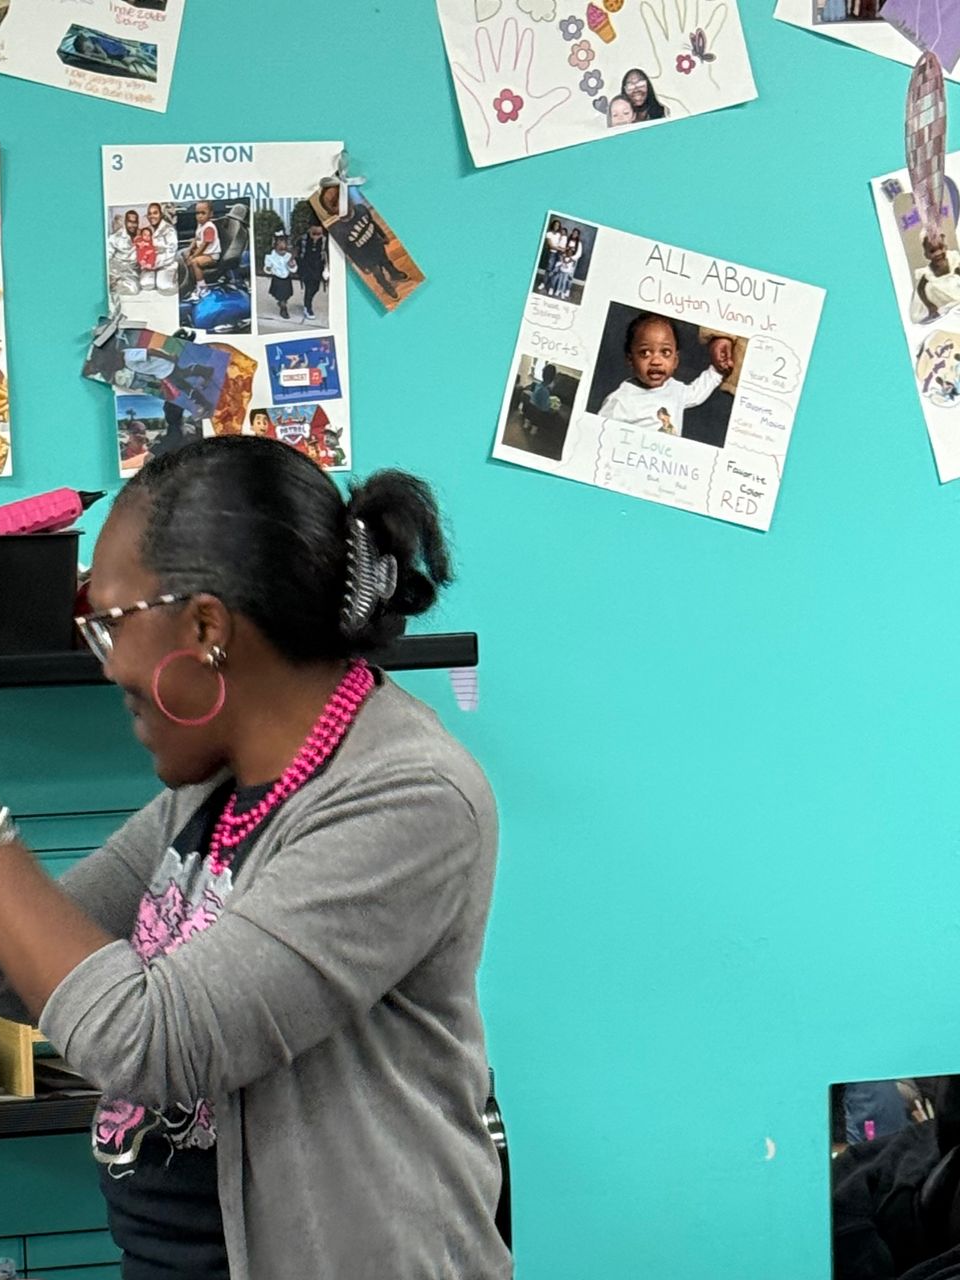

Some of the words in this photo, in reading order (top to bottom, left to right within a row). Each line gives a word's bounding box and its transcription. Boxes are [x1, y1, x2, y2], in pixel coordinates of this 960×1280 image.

[111, 153, 124, 171] 3
[185, 145, 254, 163] ASTON
[169, 182, 271, 200] VAUGHAN
[645, 244, 691, 279] ALL
[701, 260, 786, 303] ABOUT
[638, 275, 710, 314] Clayton
[716, 298, 754, 327] Vann
[530, 330, 579, 356] Sports
[772, 356, 788, 380] 2
[619, 428, 635, 445] I
[611, 447, 700, 481] LEARNING
[720, 490, 759, 515] RED
